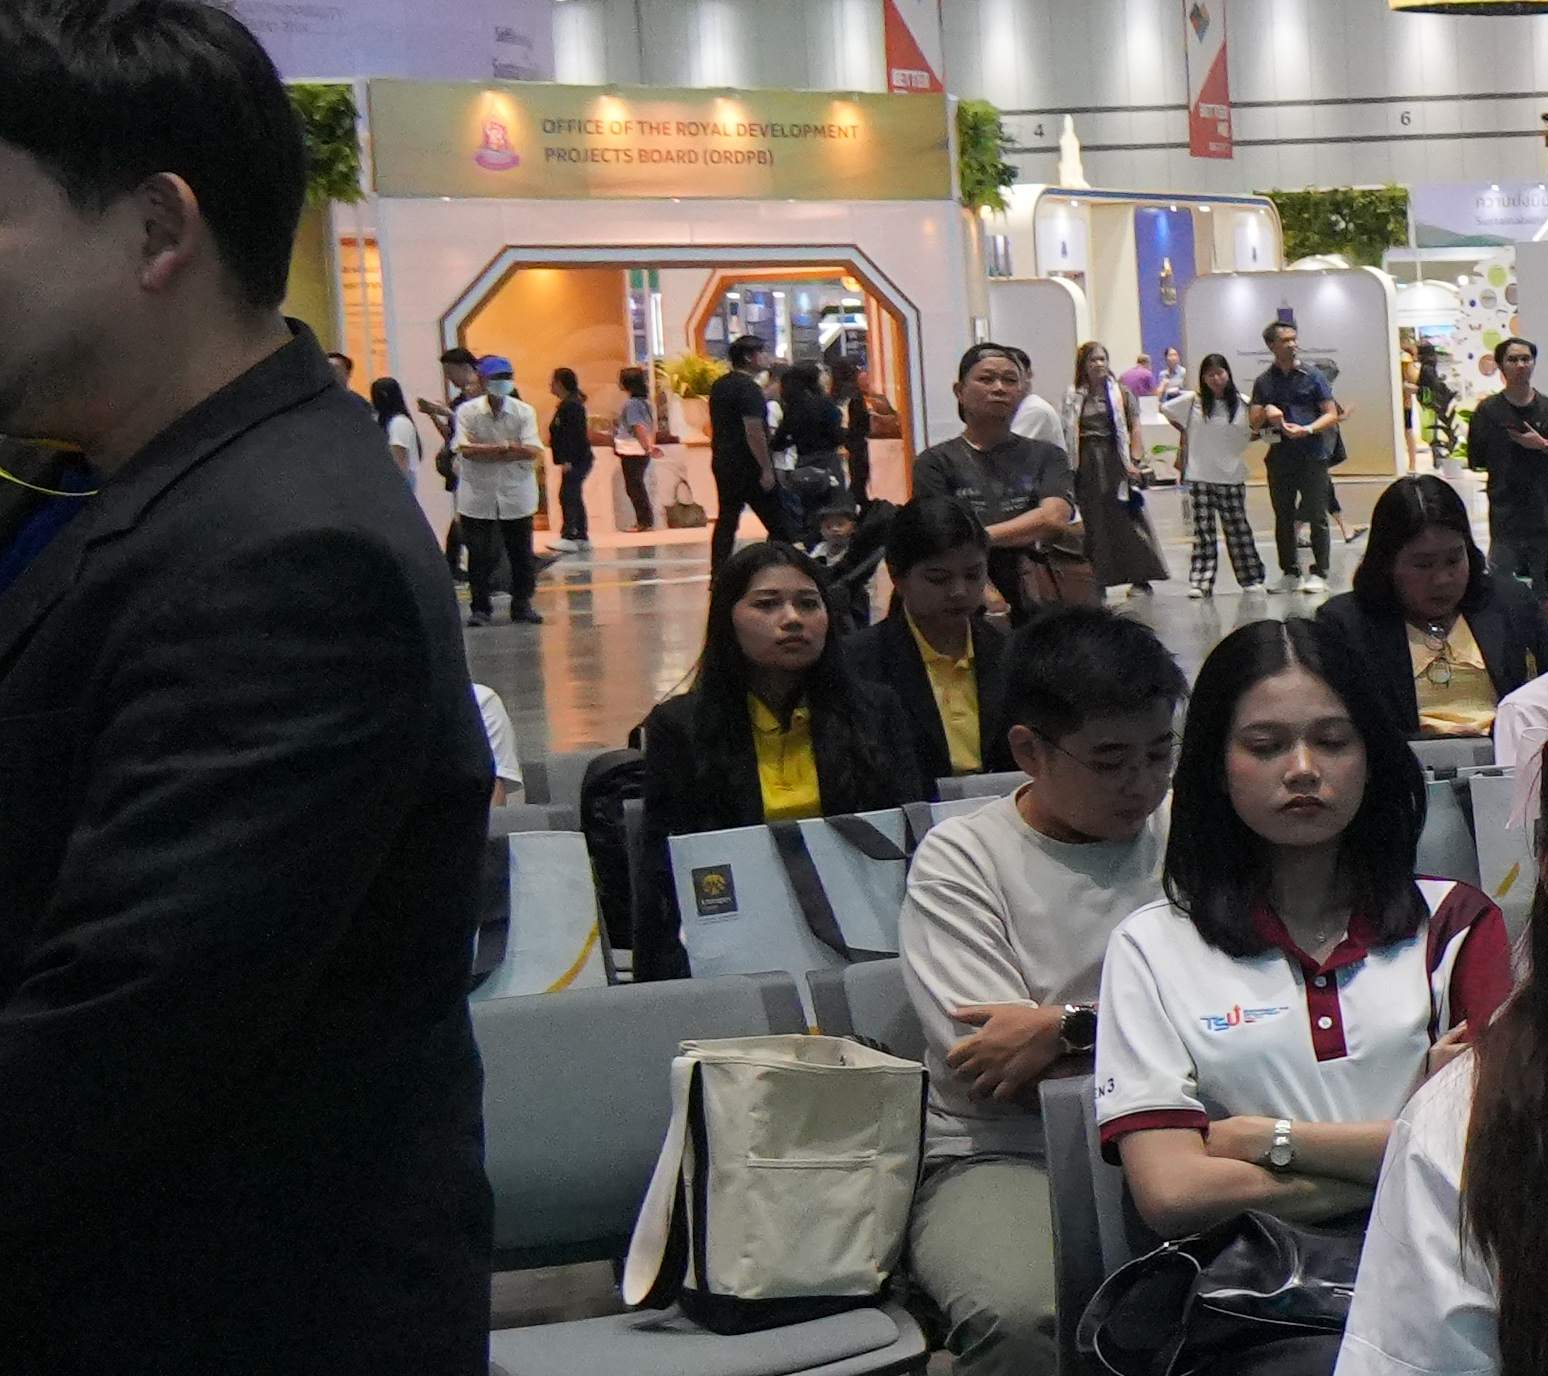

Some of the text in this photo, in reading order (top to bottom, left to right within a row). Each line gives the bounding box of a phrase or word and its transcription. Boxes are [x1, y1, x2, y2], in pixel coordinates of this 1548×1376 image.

[1399, 110, 1412, 127] 6
[543, 118, 860, 140] OFFICE OF THE ROYAL DEVELOPMENT
[1033, 123, 1046, 139] 4
[544, 147, 774, 168] PROJECTS BOARD (ORDPB)
